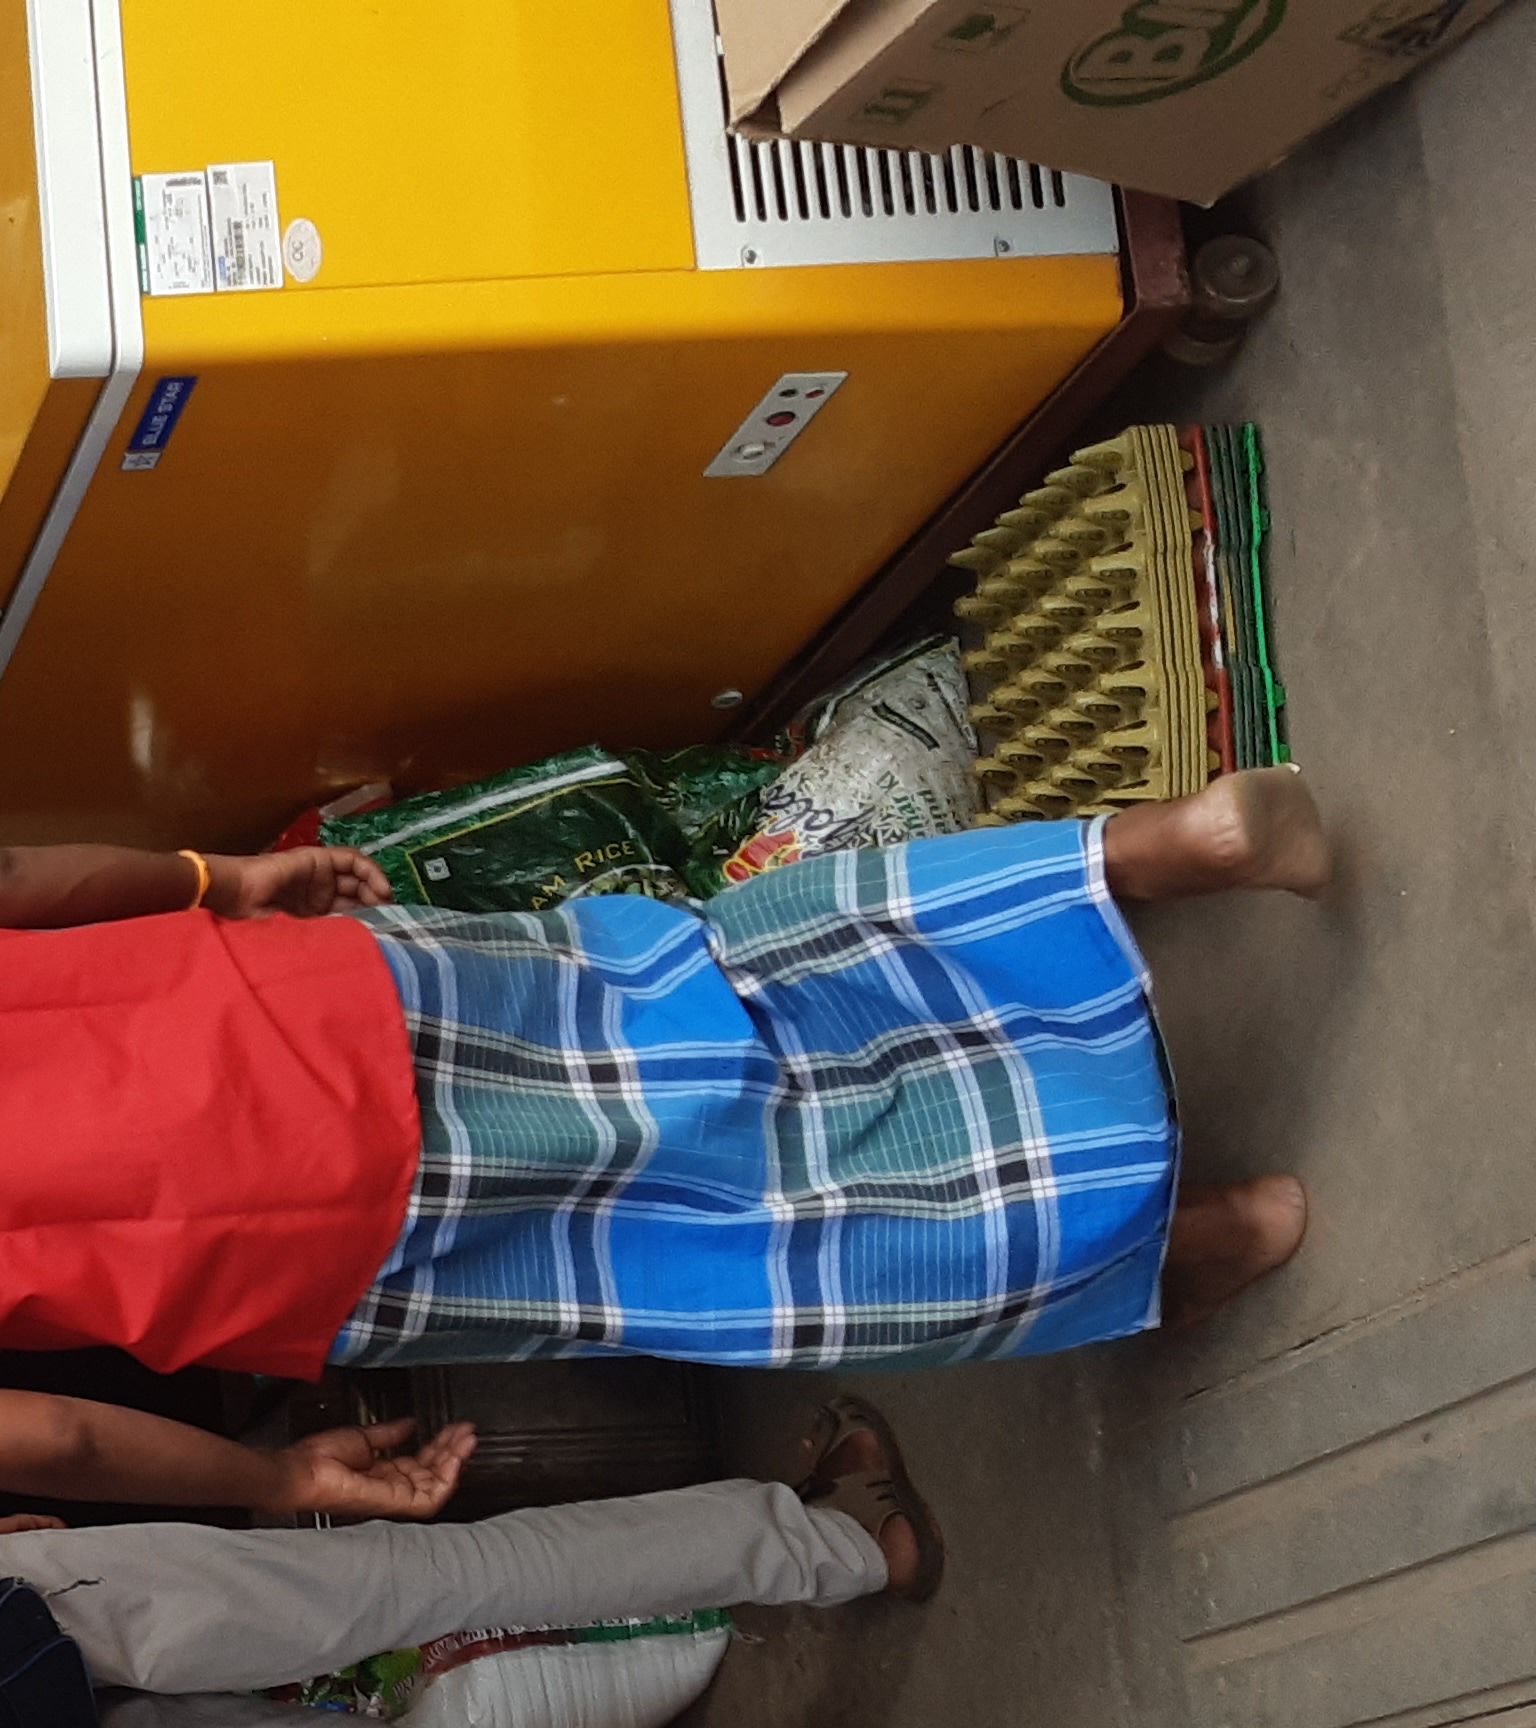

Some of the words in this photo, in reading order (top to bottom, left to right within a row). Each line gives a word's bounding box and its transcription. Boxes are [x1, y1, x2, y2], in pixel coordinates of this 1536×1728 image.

[291, 239, 304, 262] QC
[142, 414, 168, 445] BLUE
[157, 381, 184, 413] STAR
[573, 841, 636, 873] RICE
